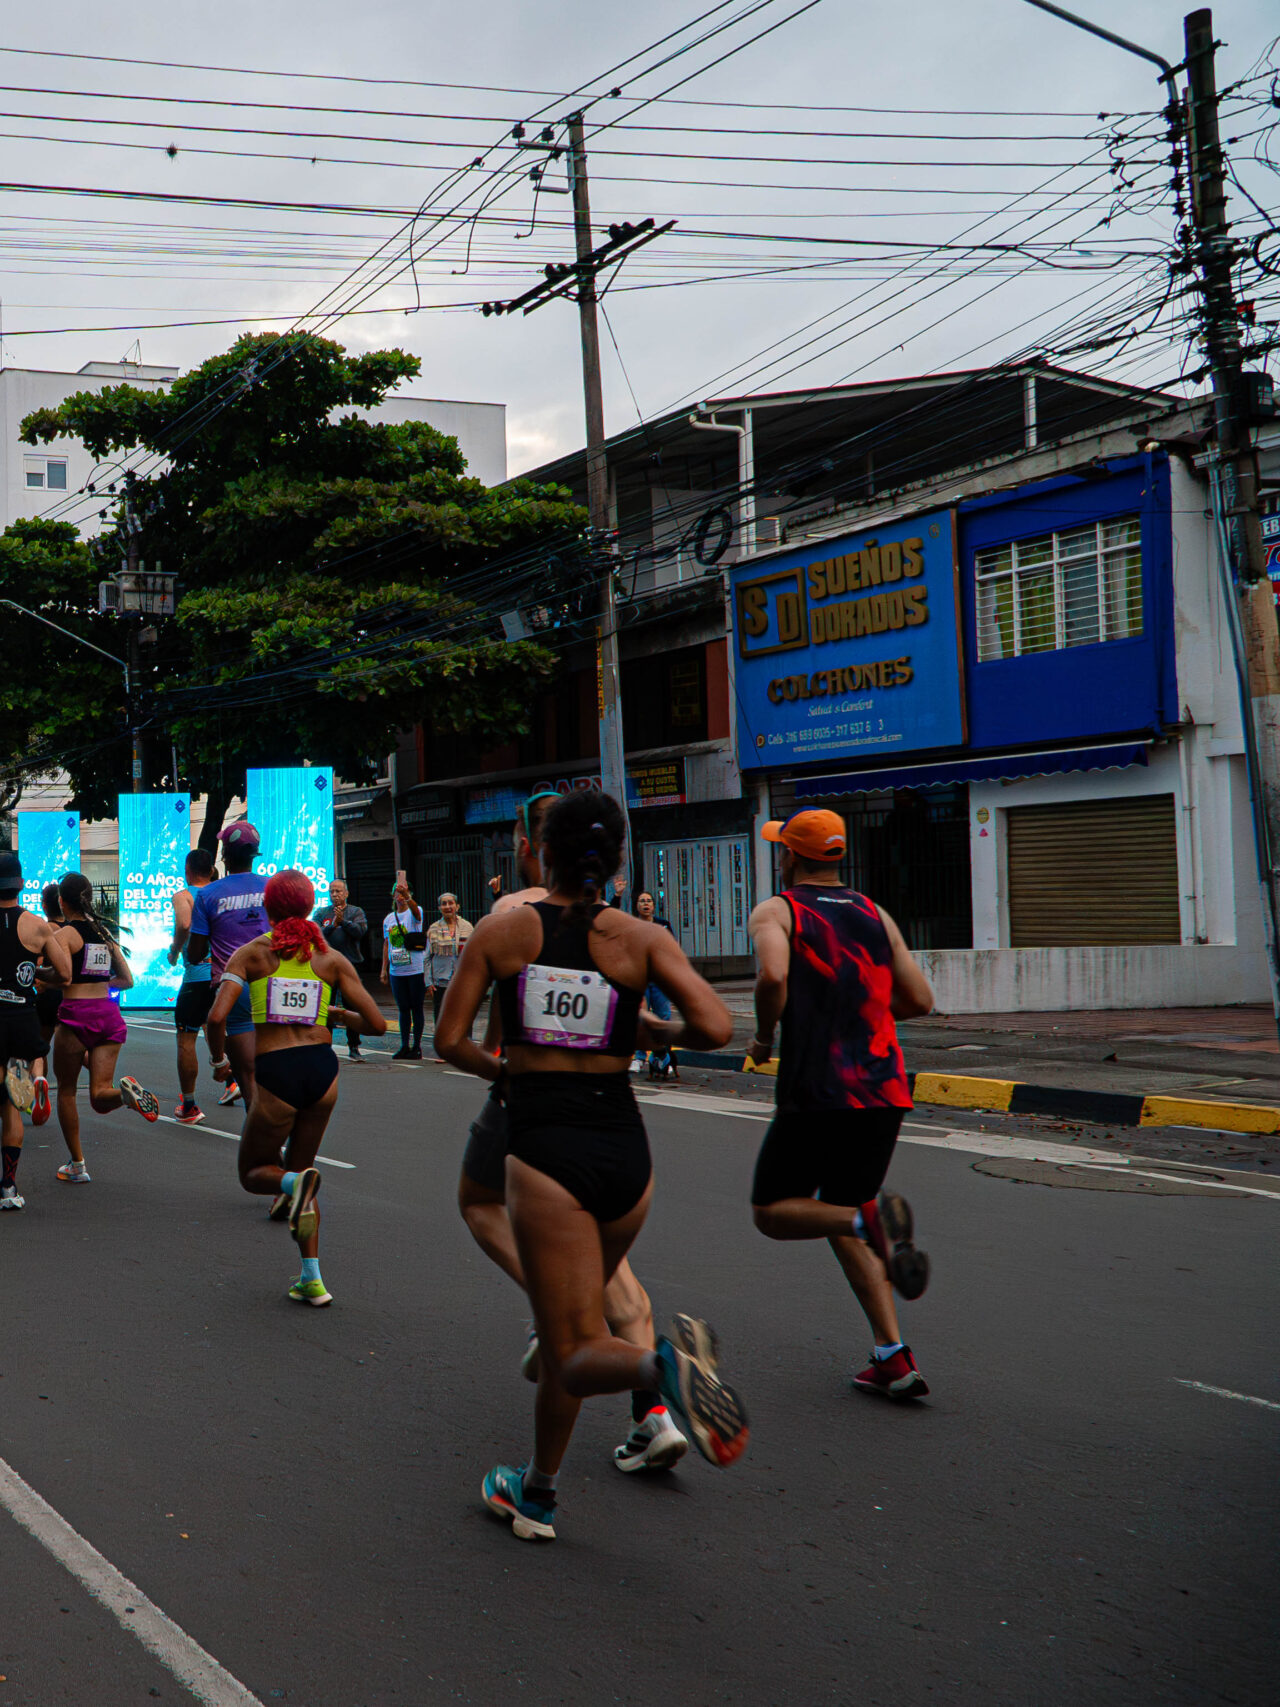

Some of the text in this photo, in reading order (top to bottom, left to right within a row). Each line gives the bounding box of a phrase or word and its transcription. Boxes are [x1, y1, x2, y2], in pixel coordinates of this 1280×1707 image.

[807, 537, 924, 600] SUEÑOS
[810, 584, 929, 645] DORADOS
[767, 656, 914, 703] COLCHONES
[257, 863, 277, 876] 60
[25, 880, 39, 889] 60
[127, 872, 184, 888] 60 AÑOS
[124, 889, 148, 899] DEL
[124, 900, 138, 909] DE
[140, 901, 161, 910] LOS
[123, 911, 174, 927] HACE
[94, 954, 107, 965] 161
[282, 992, 308, 1008] 159
[542, 990, 588, 1019] 160
